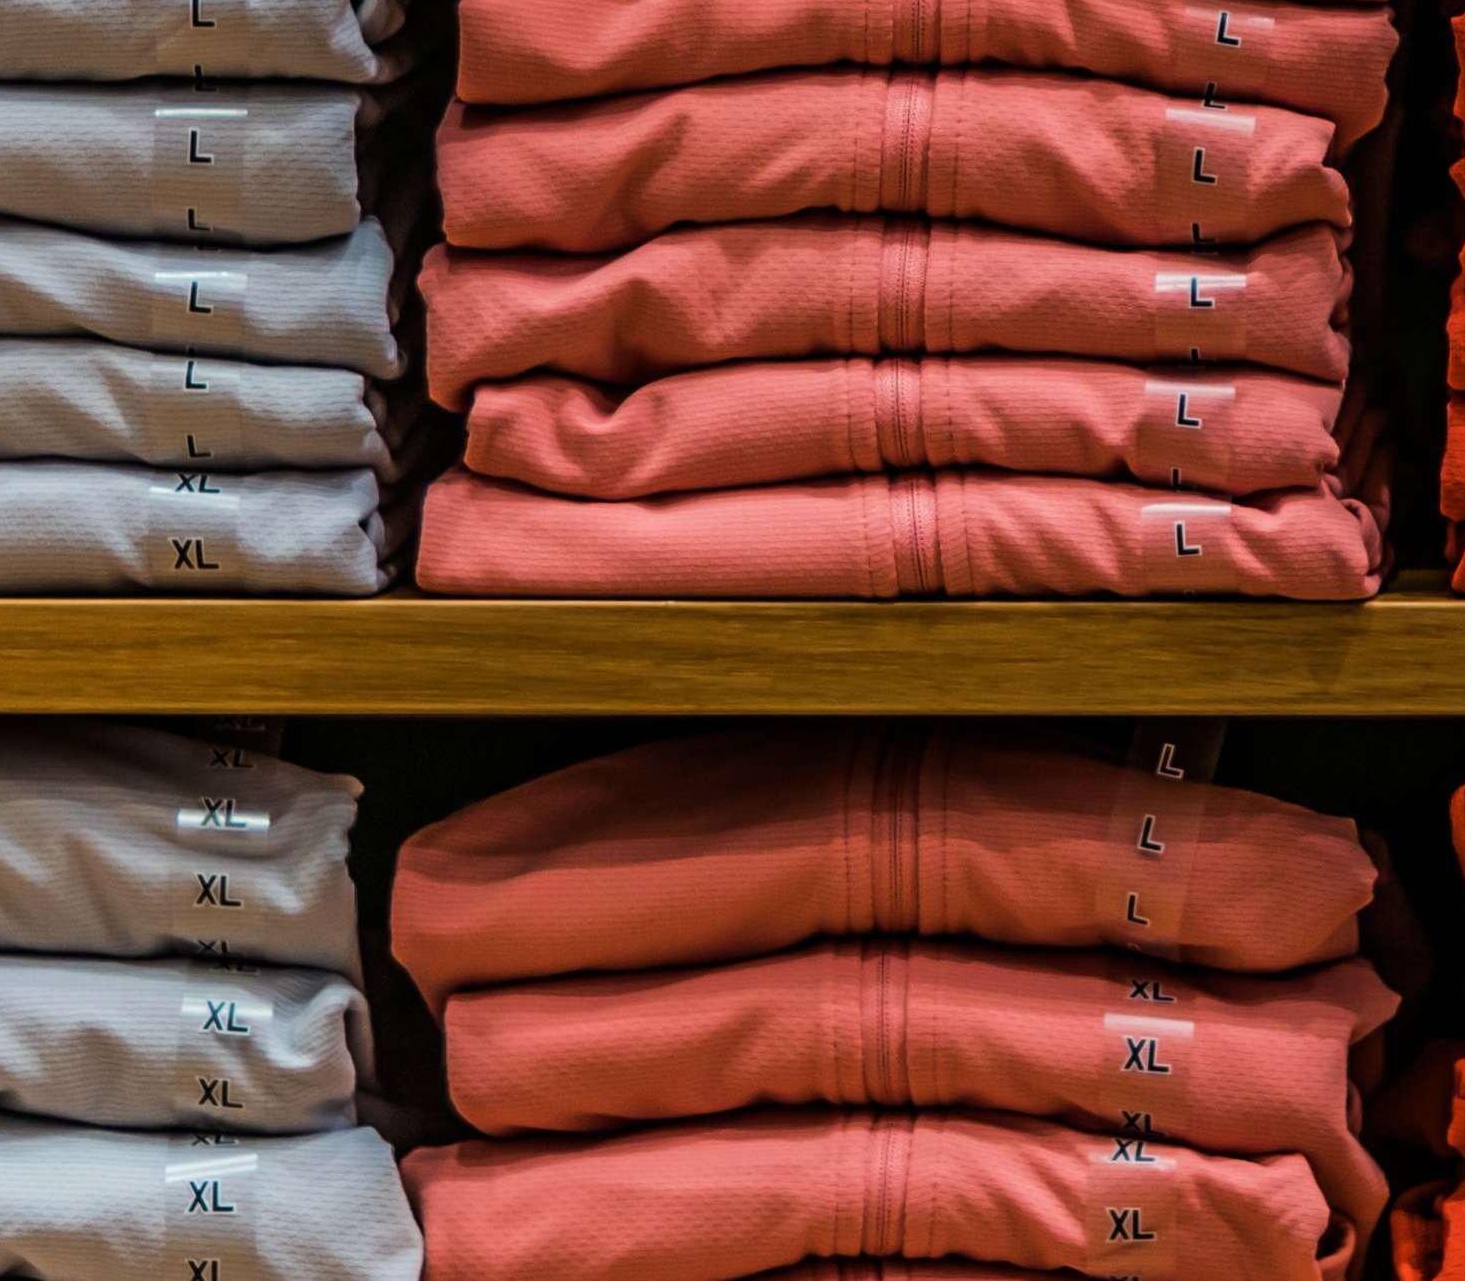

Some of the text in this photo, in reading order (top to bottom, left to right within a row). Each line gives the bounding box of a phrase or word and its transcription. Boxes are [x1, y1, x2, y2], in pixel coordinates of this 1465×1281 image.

[1216, 11, 1241, 47] L
[1203, 83, 1226, 110] L
[189, 130, 213, 163] L
[1192, 148, 1217, 185] L
[188, 209, 211, 231] L
[189, 281, 211, 313] L
[1191, 277, 1214, 308] L
[186, 360, 207, 389] L
[1177, 392, 1201, 428] L
[187, 435, 211, 458] L
[175, 474, 220, 493] XL
[172, 539, 220, 569] XL
[1175, 522, 1201, 556] L
[210, 749, 255, 768] XL
[1157, 743, 1184, 779] L
[201, 798, 247, 828] XL
[1138, 815, 1164, 854] L
[196, 874, 243, 906] XL
[1127, 893, 1150, 927] L
[1130, 980, 1175, 1003] XL
[204, 1001, 250, 1032] XL
[1123, 1037, 1171, 1074] XL
[199, 1078, 243, 1109] XL
[1112, 1139, 1156, 1162] XL
[189, 1181, 235, 1212] XL
[1107, 1209, 1155, 1241] XL
